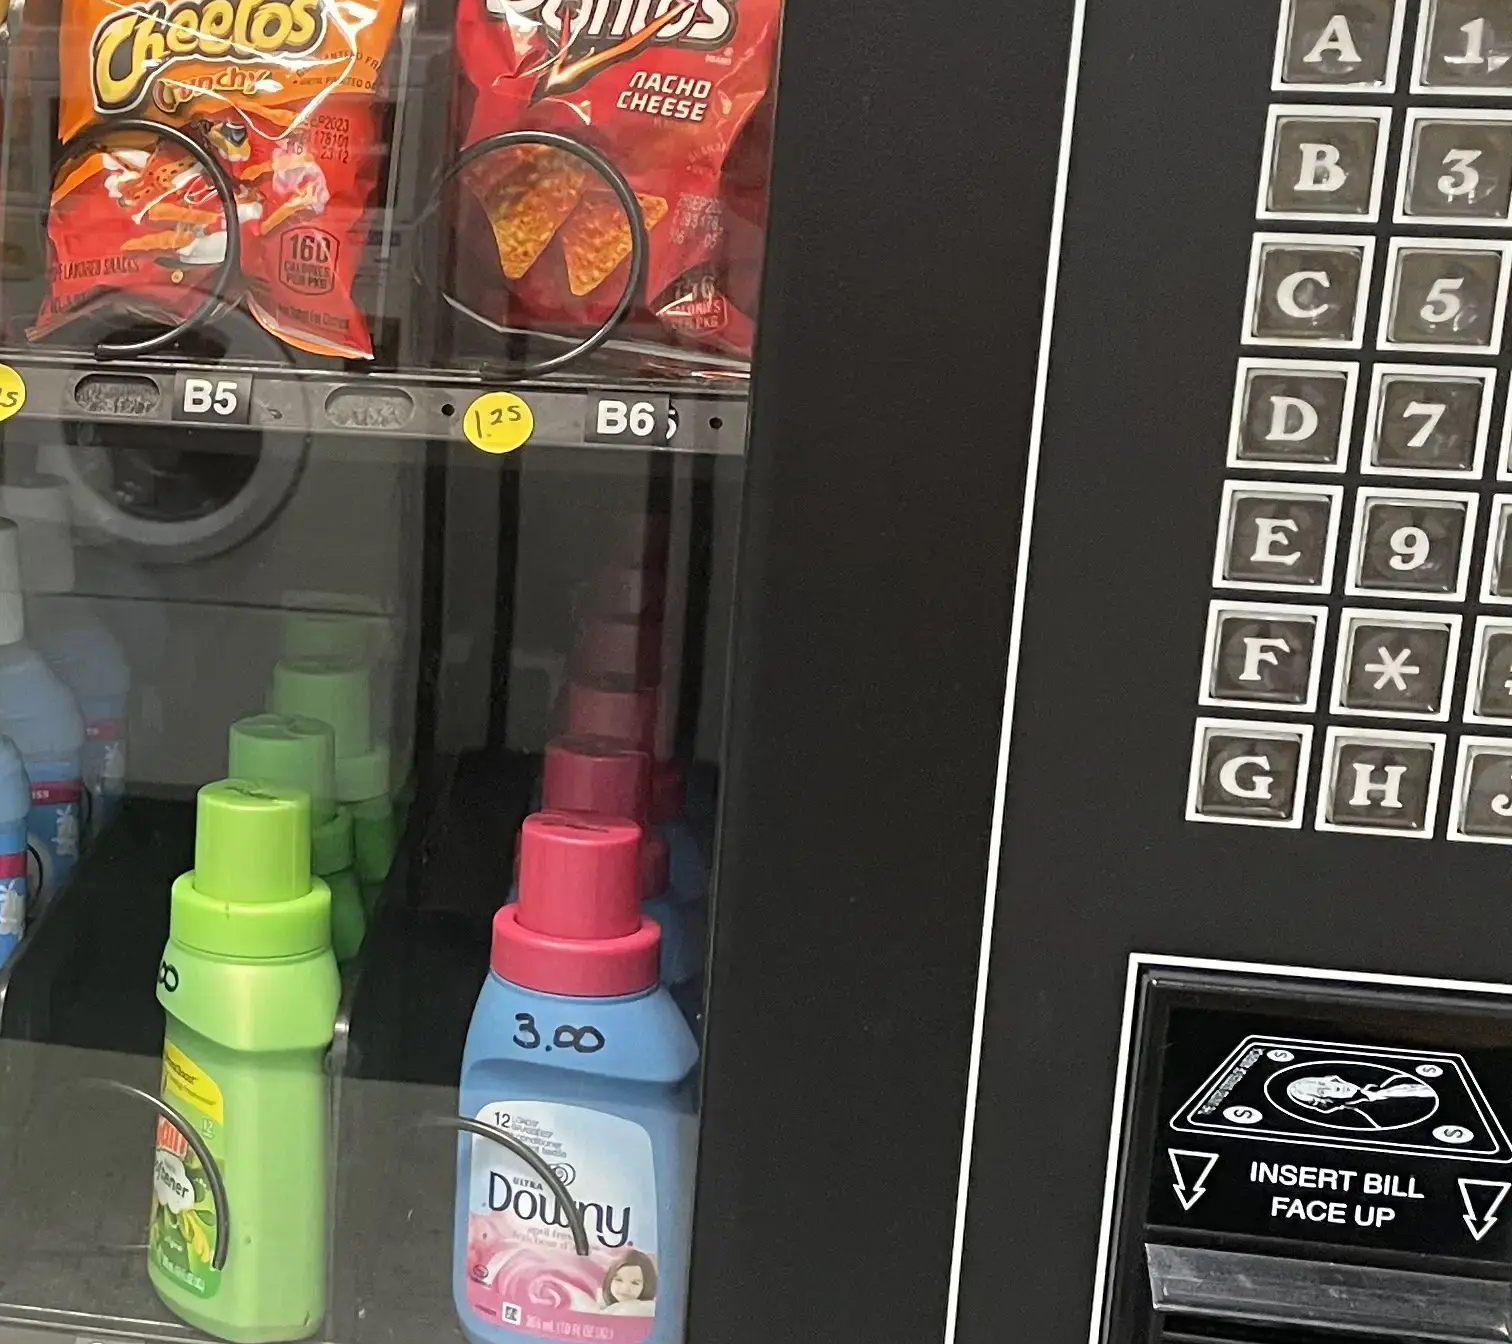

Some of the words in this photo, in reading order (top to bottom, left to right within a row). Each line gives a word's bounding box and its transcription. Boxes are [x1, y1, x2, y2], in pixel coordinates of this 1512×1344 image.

[1303, 14, 1362, 63] A
[1457, 17, 1488, 63] 1
[152, 64, 267, 114] Crunchy
[616, 91, 708, 122] CHEESE
[628, 70, 712, 100] NACHO
[1295, 144, 1347, 192] B
[1437, 149, 1481, 194] 3
[289, 234, 332, 263] 160
[1276, 270, 1332, 319] C
[1420, 275, 1464, 324] 5
[183, 380, 238, 416] B5
[597, 400, 656, 438] B6
[1265, 394, 1320, 441] D
[474, 405, 523, 440] 1.25
[1403, 402, 1447, 447] 7
[1250, 517, 1302, 564] E
[1389, 524, 1431, 572] 9
[1238, 636, 1291, 681] F
[1218, 755, 1273, 801] G
[1349, 762, 1407, 808] H
[512, 1012, 605, 1053] 3.00
[493, 1111, 511, 1129] 12
[512, 1176, 544, 1192] ULTRA
[1249, 1161, 1358, 1192] INSERT
[1363, 1173, 1425, 1199] BILL
[489, 1170, 631, 1249] Downy
[1271, 1196, 1348, 1223] FACE
[1354, 1205, 1396, 1228] UP
